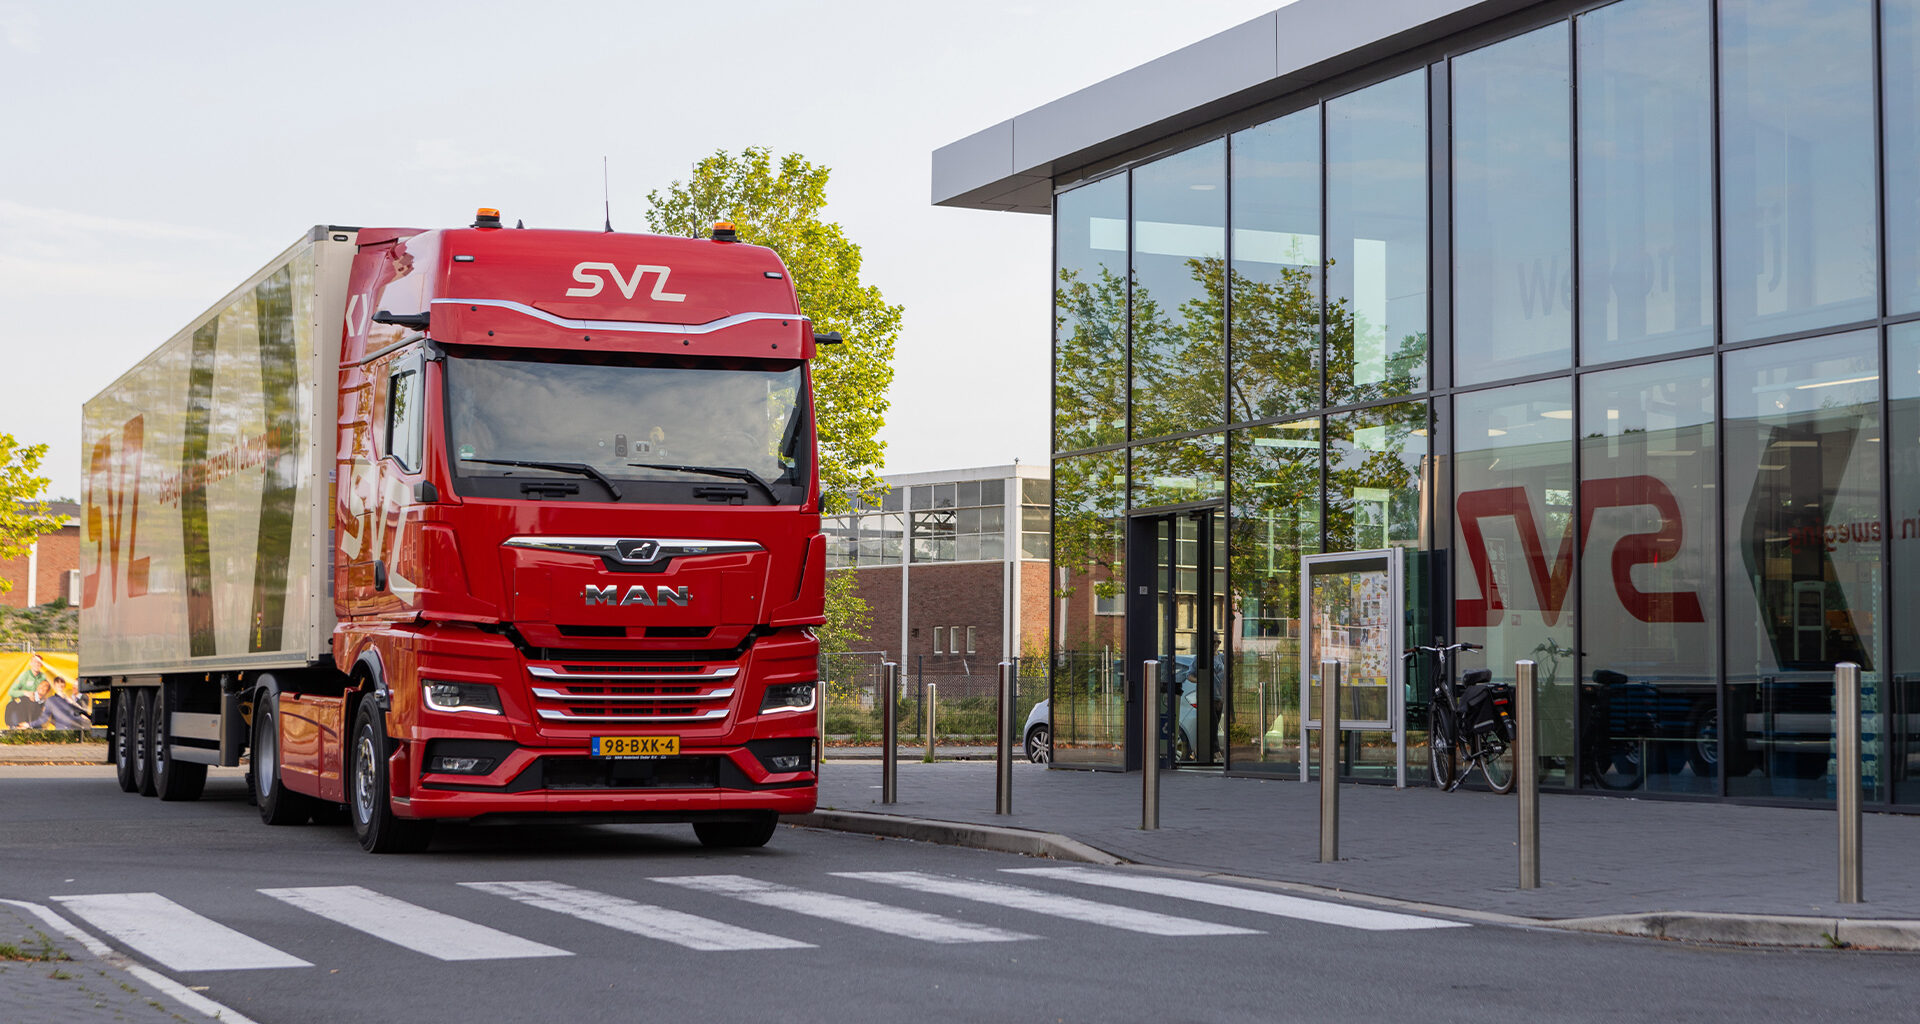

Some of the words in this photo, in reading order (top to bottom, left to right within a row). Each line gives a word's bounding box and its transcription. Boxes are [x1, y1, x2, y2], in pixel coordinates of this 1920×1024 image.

[565, 261, 687, 302] SVZ
[231, 436, 239, 474] in
[82, 414, 150, 609] SVZ
[340, 456, 417, 607] SVZ
[585, 584, 689, 607] MAN
[604, 739, 675, 753] 98-BXK-4
